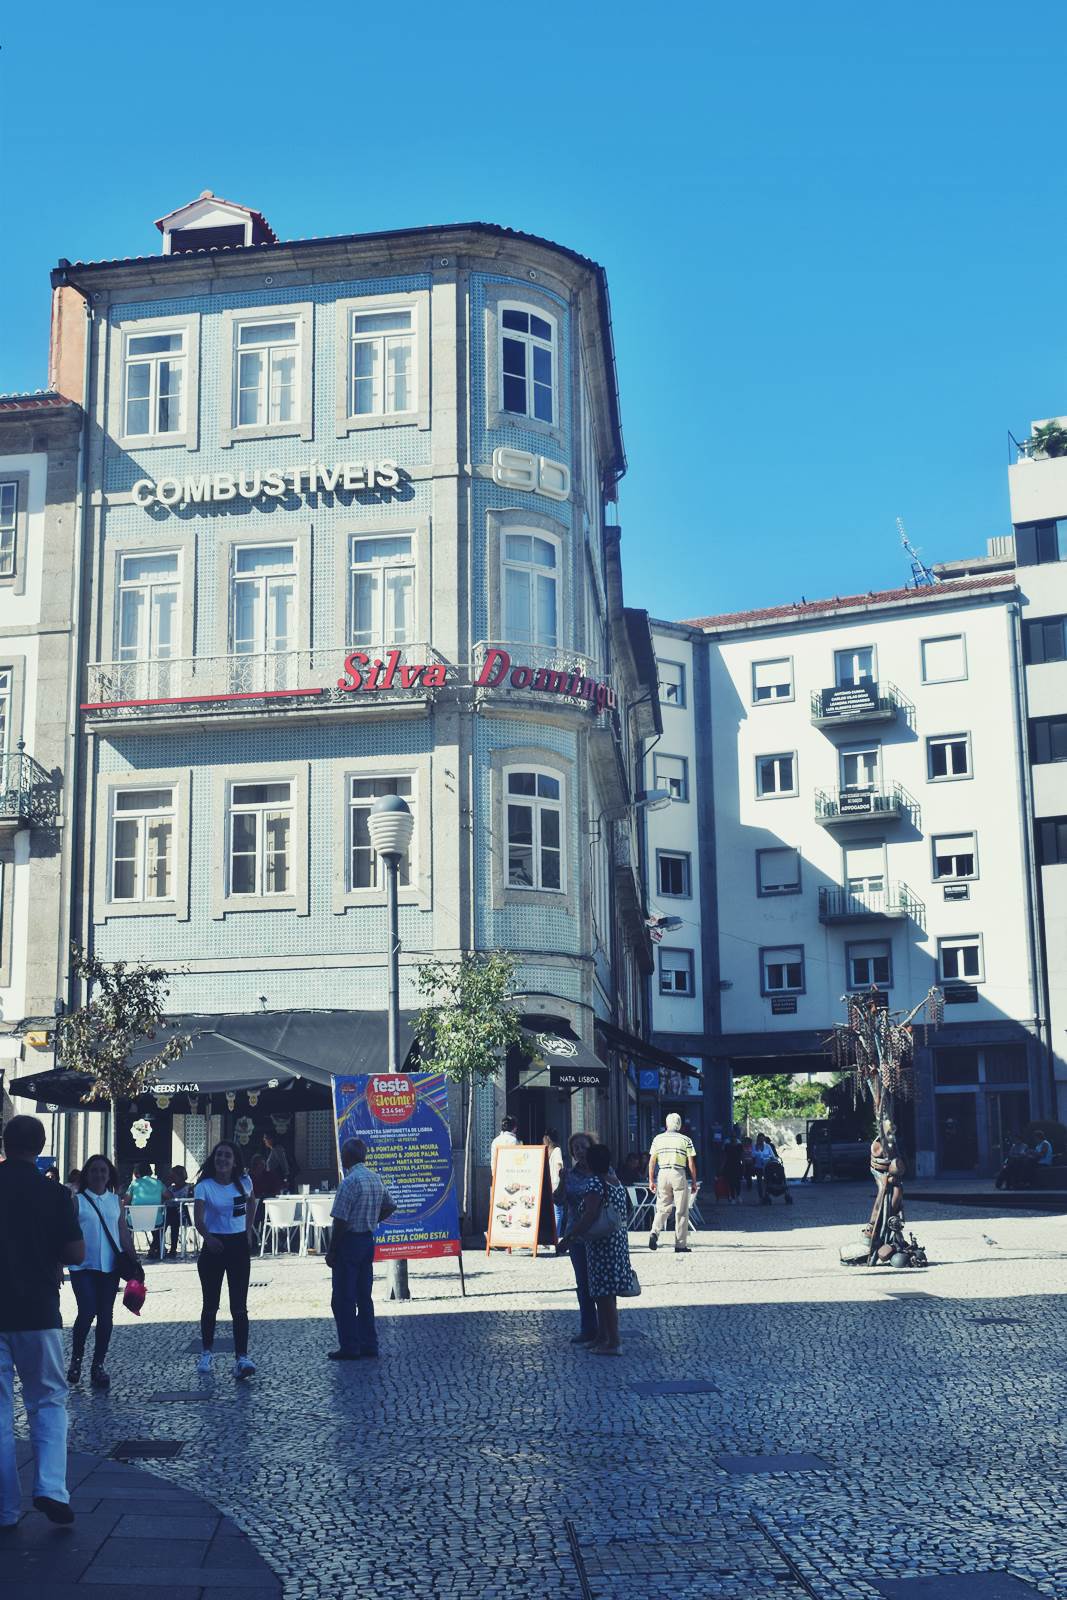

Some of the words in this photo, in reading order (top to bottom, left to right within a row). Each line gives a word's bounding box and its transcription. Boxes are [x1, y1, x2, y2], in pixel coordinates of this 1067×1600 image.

[131, 458, 400, 507] COMBUSTÍVEIS
[337, 649, 447, 692] Silva
[372, 1078, 409, 1092] festa
[578, 1075, 600, 1084] LISBOA
[150, 1084, 175, 1093] NEEDS
[176, 1083, 200, 1093] NATA
[387, 1233, 409, 1243] FESTA
[409, 1232, 429, 1241] COMO
[429, 1231, 449, 1240] ESTA!
